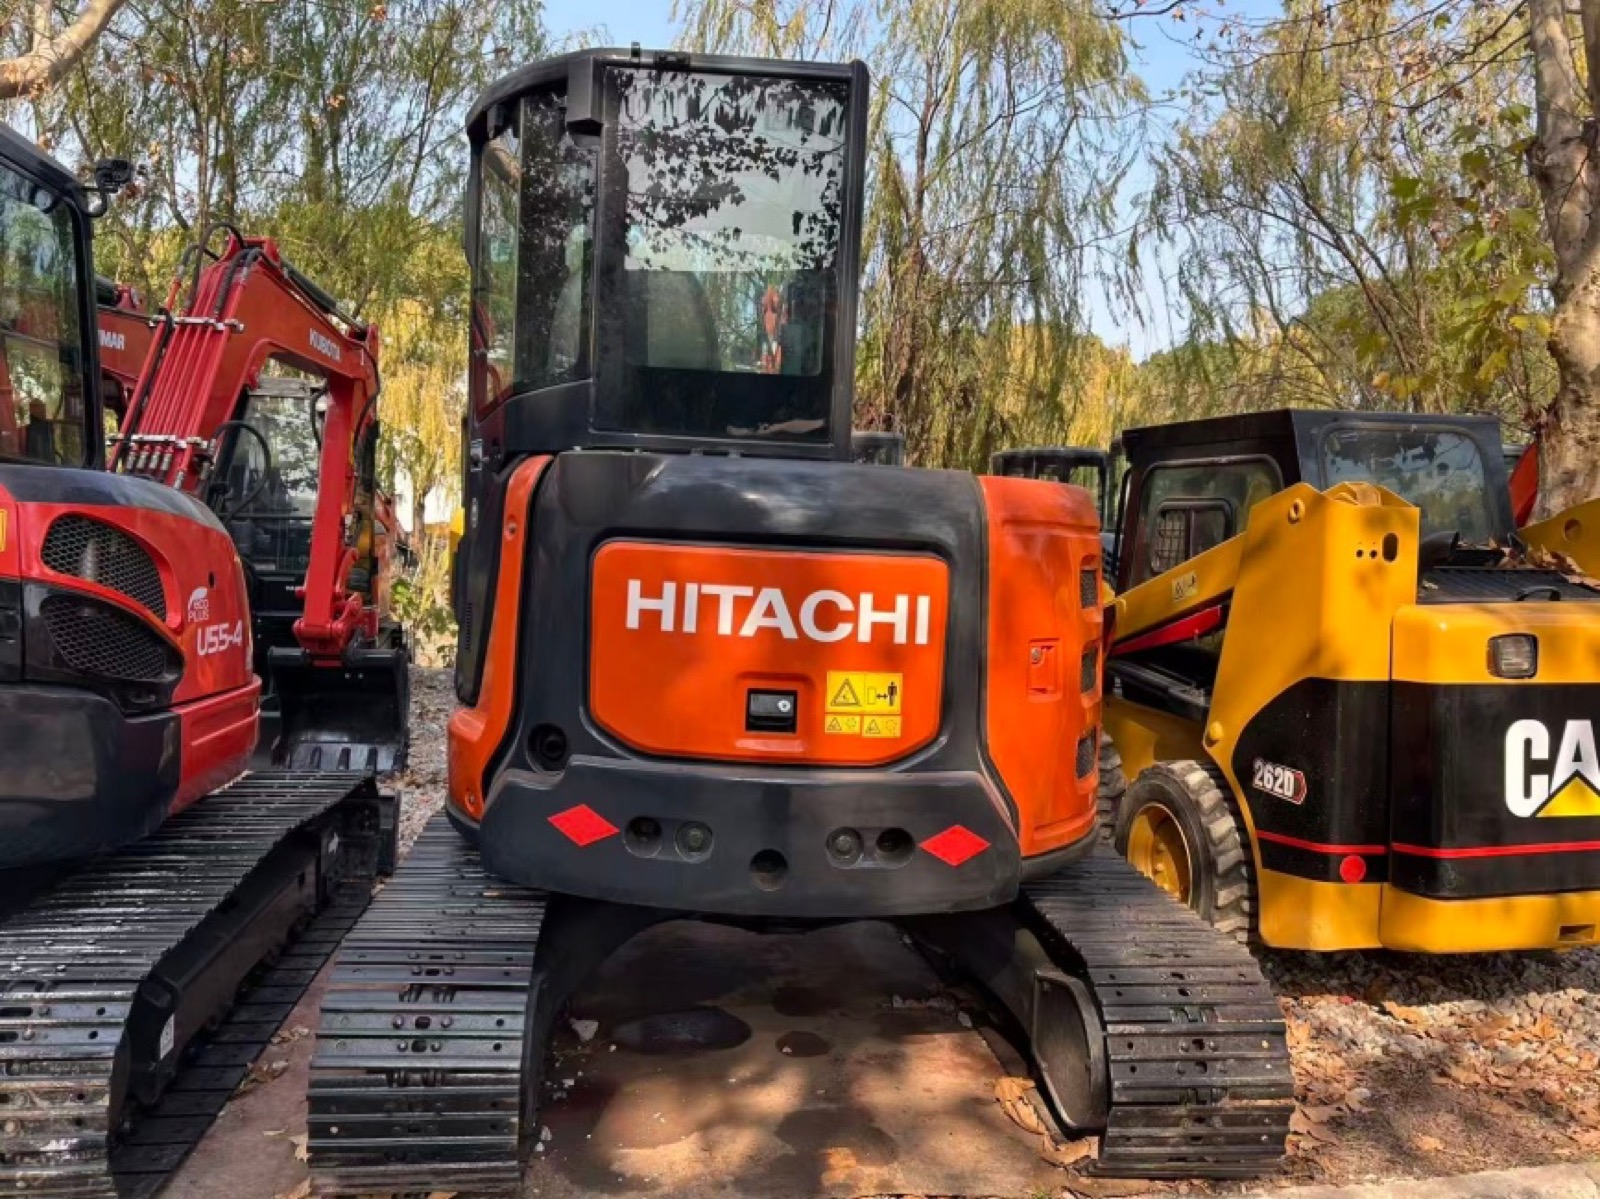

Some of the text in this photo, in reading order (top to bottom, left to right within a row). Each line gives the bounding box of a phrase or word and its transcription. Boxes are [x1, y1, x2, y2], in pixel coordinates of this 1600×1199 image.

[625, 578, 931, 645] HITACHI
[196, 619, 243, 656] U55-4
[1254, 760, 1295, 798] 262D
